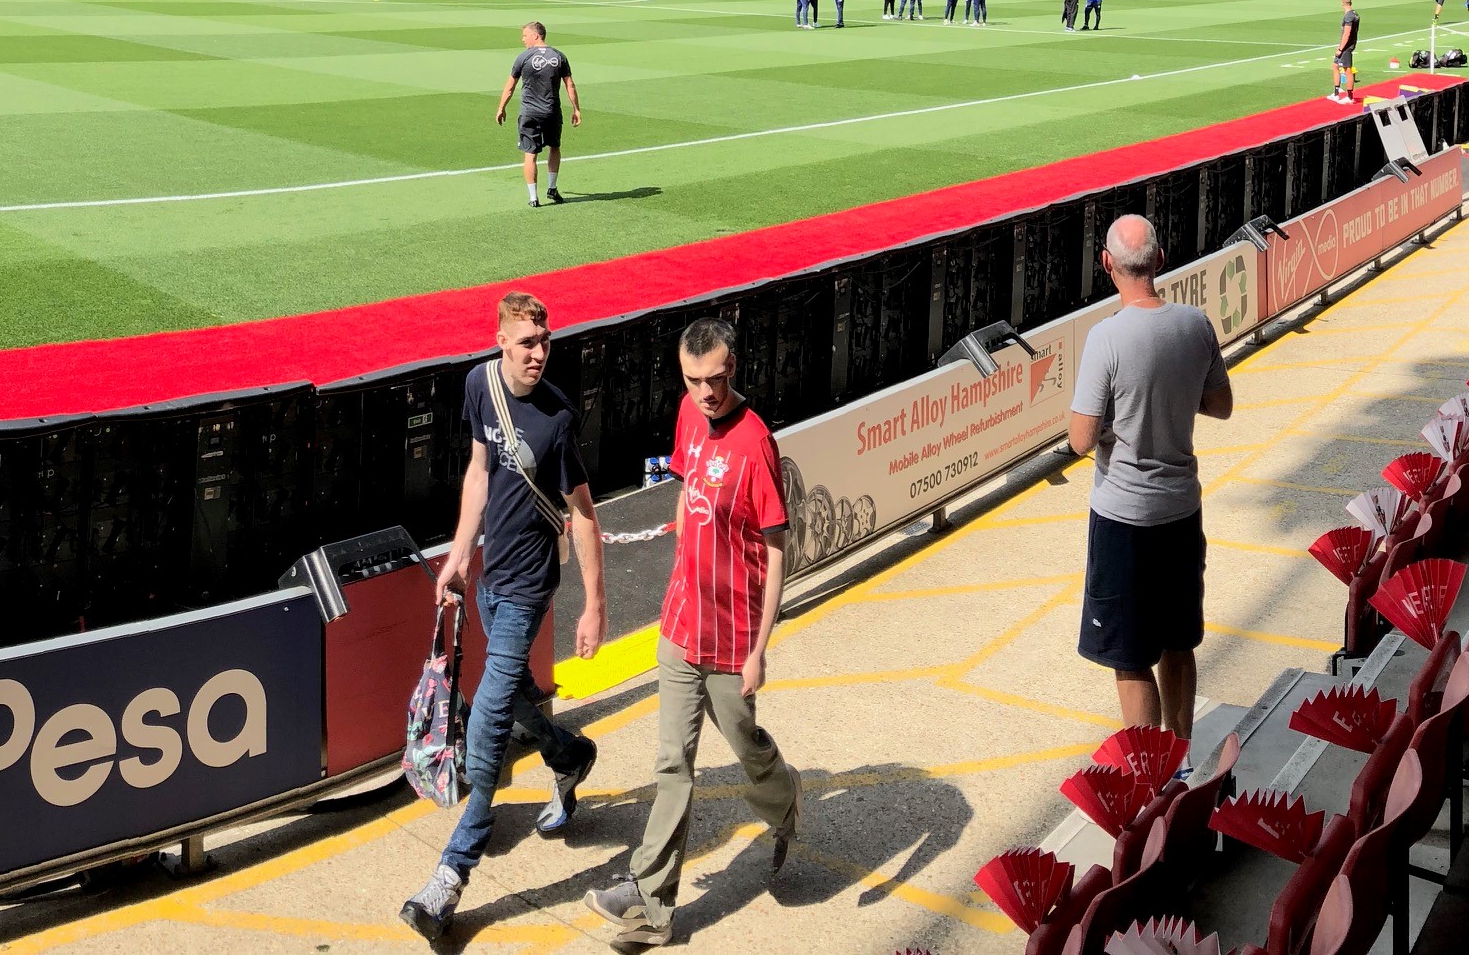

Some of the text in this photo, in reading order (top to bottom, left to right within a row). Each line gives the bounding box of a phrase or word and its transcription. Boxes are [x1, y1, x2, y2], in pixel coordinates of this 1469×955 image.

[1342, 167, 1460, 249] PROUD TO BE IN THAT NUMBER.
[1317, 234, 1337, 256] media
[1171, 269, 1207, 308] TYRE
[857, 361, 1023, 456] Smart Alloy Hampshire
[888, 400, 1024, 476] Mobile Alloy Wheel Refurbishment
[984, 412, 1066, 461] www.smartalloyhampshire.co.uk
[910, 451, 979, 499] 07500 730912
